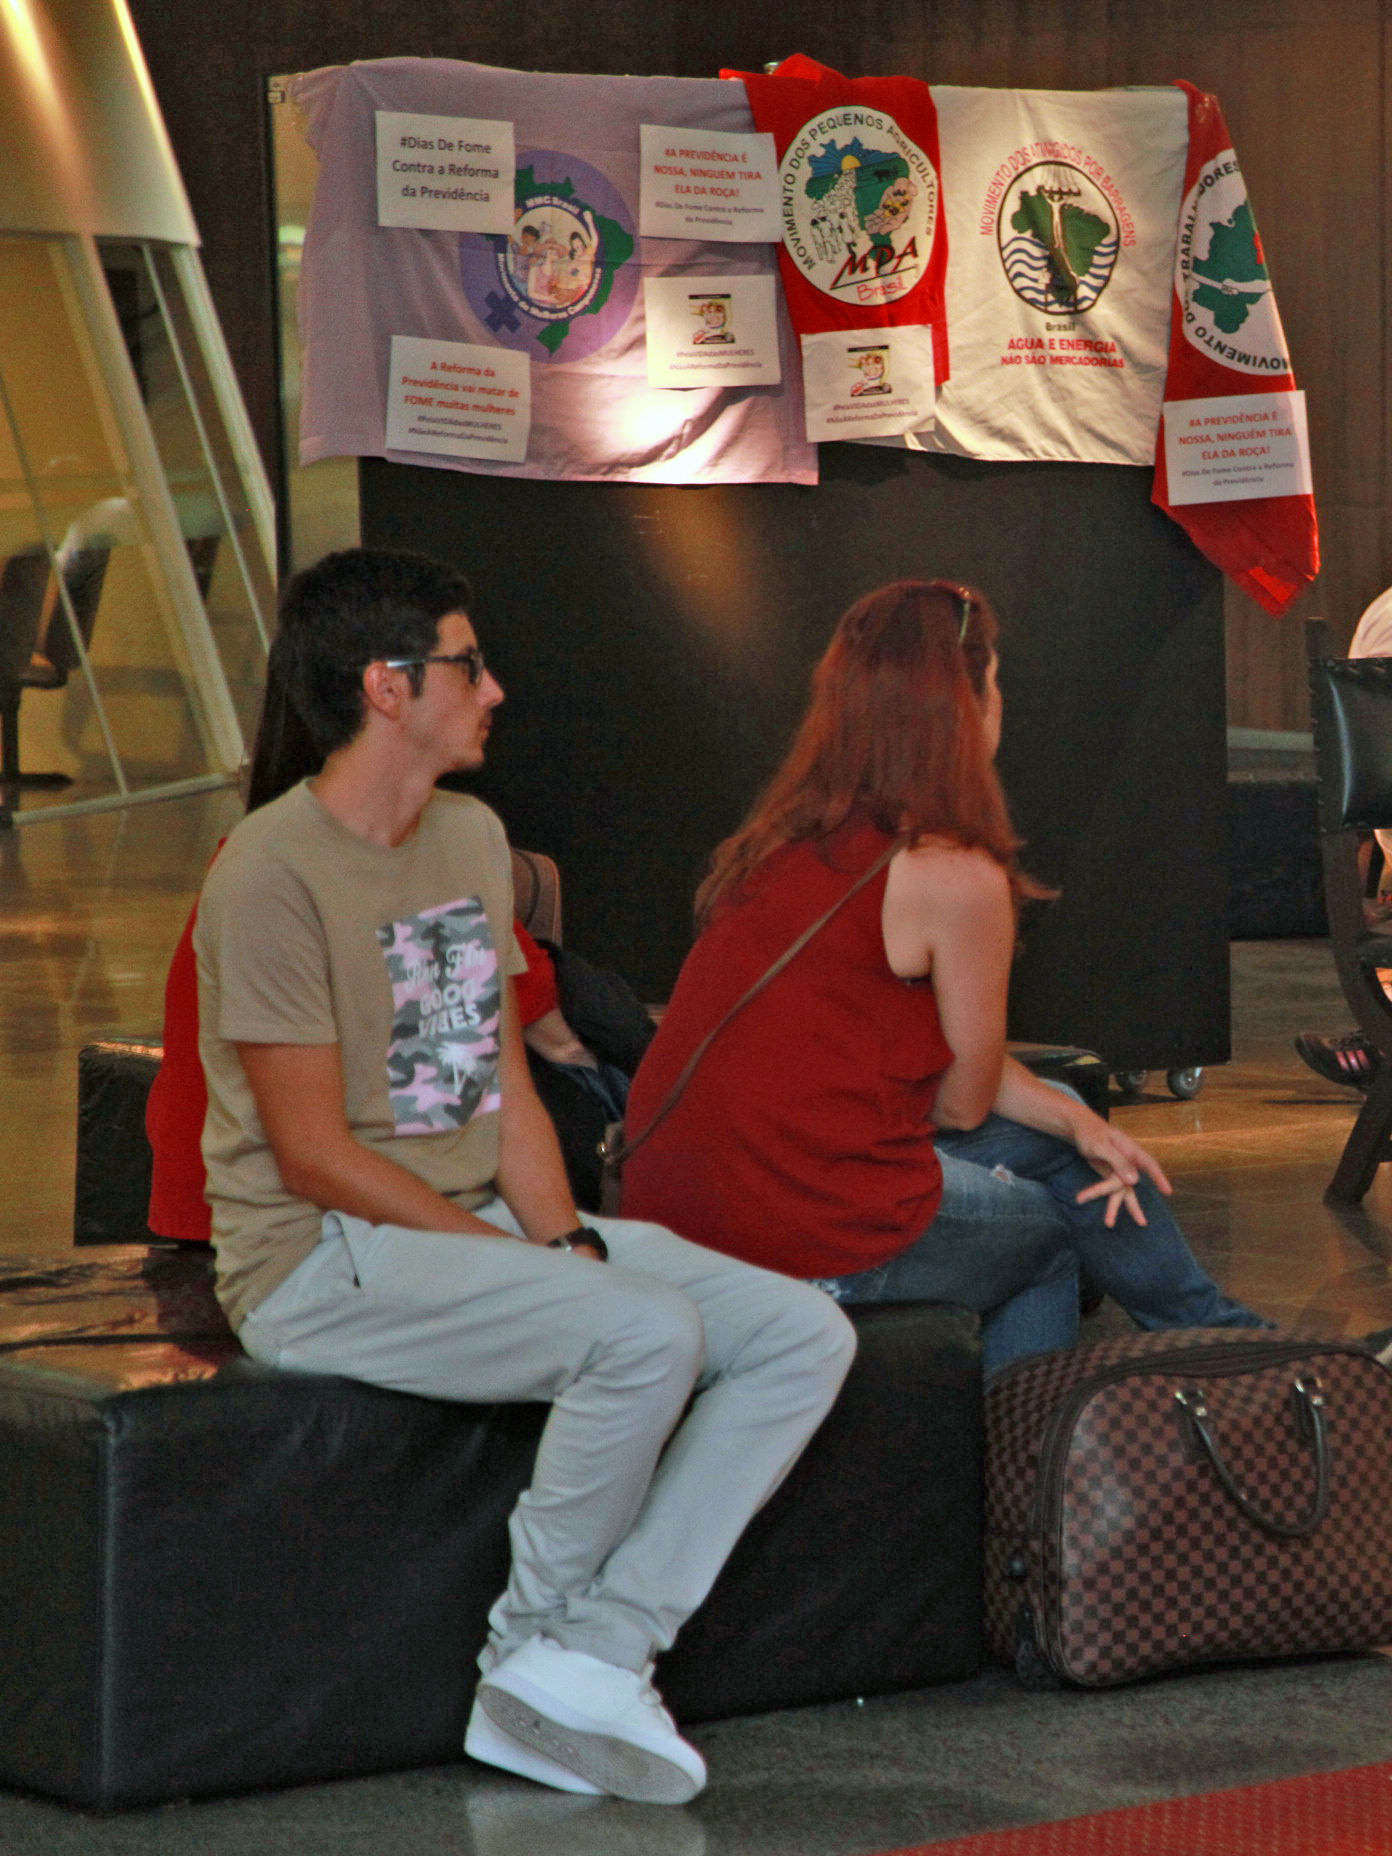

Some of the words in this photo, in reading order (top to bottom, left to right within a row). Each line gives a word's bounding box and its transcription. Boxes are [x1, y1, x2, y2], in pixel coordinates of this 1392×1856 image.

[400, 136, 434, 150] #Dias
[438, 138, 454, 151] De
[458, 140, 492, 154] Fome
[789, 138, 811, 170] DOS
[679, 148, 739, 162] PREVIDÊNCIA
[392, 160, 434, 175] Contra
[438, 166, 445, 175] a
[448, 163, 499, 179] Reforma
[654, 165, 687, 177] NOSSA,
[738, 171, 763, 180] TIRA
[401, 185, 416, 198] da
[420, 186, 490, 202] Previdência
[675, 184, 691, 194] ELA
[693, 186, 707, 195] DA
[710, 187, 740, 198] ROÇA!
[980, 164, 1013, 235] MOVIMENTO
[1008, 147, 1031, 171] DOS
[1084, 155, 1104, 181] POR
[1101, 175, 1137, 247] BARRAGENS
[782, 172, 817, 270] MOVIMENTO
[830, 236, 919, 290] MPA
[857, 277, 909, 301] Brasil
[1046, 322, 1075, 331] Brasil
[1048, 338, 1056, 350] E
[1059, 338, 1117, 353] ENERGIA
[1001, 353, 1022, 365] NÃO
[1025, 352, 1046, 365] SÃO
[1050, 355, 1125, 368] MERCADORIAS
[430, 362, 437, 370] A
[441, 362, 481, 376] Reforma
[484, 367, 495, 378] da
[402, 376, 459, 392] Previdência
[462, 385, 475, 393] vai
[478, 386, 506, 397] matar
[508, 388, 519, 398] de
[404, 395, 434, 406] FOME
[437, 400, 469, 411] muitas
[472, 403, 516, 416] mulheres
[1204, 412, 1269, 426] PREVIDÊNCIA
[1271, 411, 1278, 421] É
[1178, 433, 1215, 445] NOSSA,
[1216, 429, 1266, 442] NINGUÉM
[1269, 427, 1293, 437] TIRA
[1202, 450, 1219, 460] ELA
[1222, 449, 1236, 458] DA
[1238, 446, 1270, 458] ROÇA!
[418, 1004, 481, 1039] VIBES
